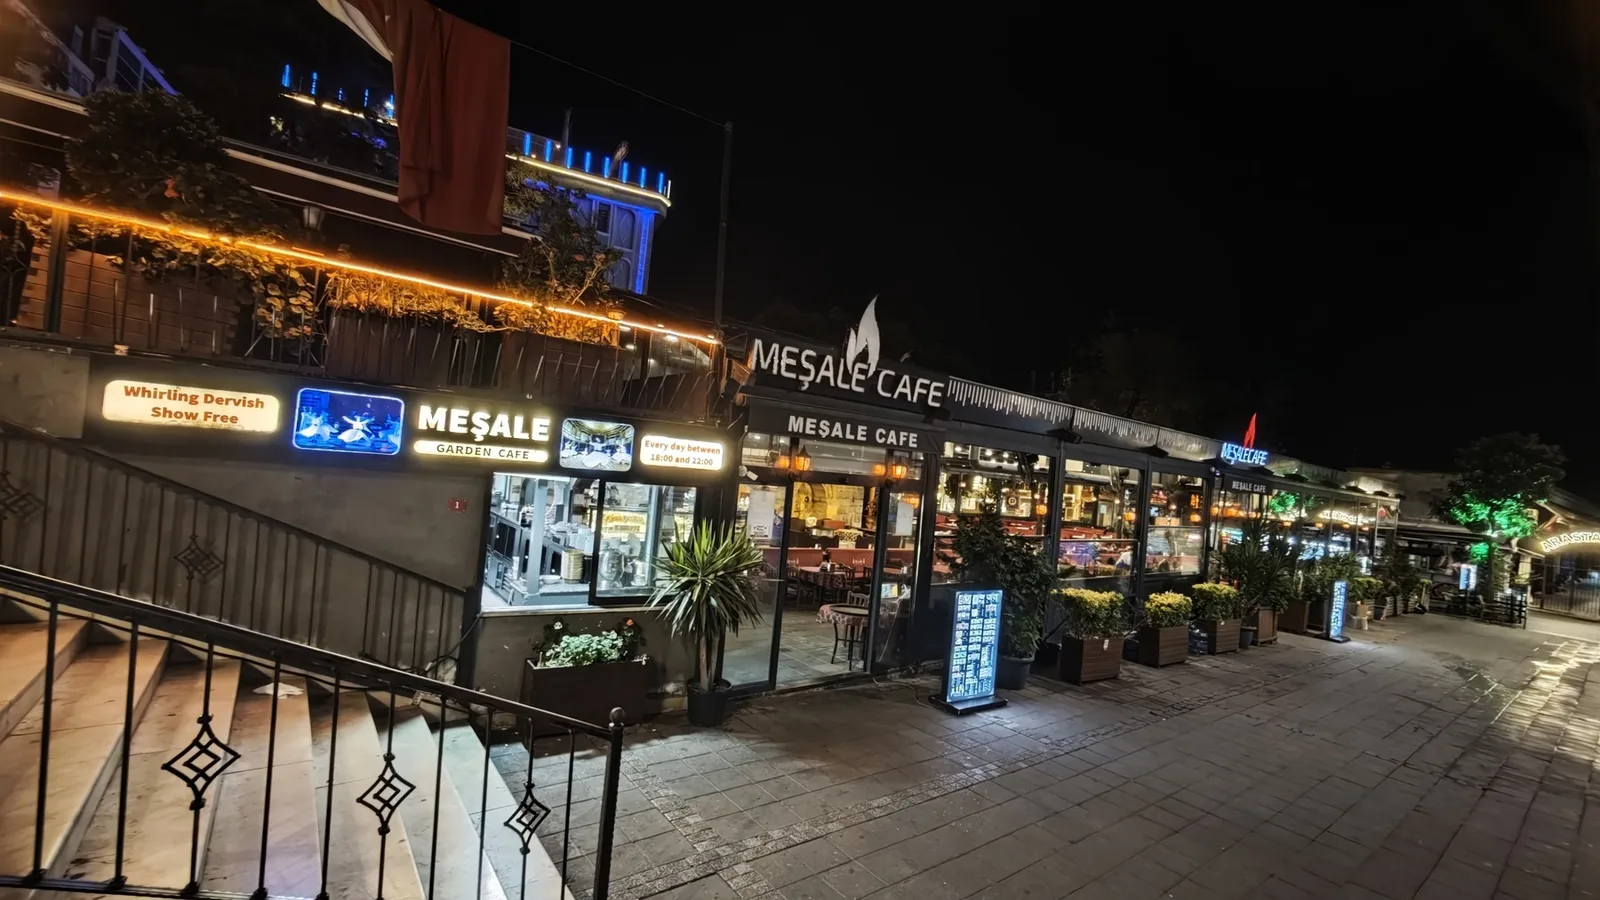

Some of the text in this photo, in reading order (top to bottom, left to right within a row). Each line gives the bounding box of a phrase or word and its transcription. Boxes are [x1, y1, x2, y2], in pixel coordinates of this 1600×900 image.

[751, 338, 945, 407] MEŞALE CAFE
[124, 385, 264, 409] Whirling Dervish
[151, 406, 239, 424] Show Free
[418, 405, 550, 442] MEŞALE
[788, 415, 918, 448] MEŞALE CAFE
[436, 444, 529, 459] GARDEN CAFE
[644, 440, 720, 454] Every day between
[650, 454, 714, 466] 18:00 and 22:00
[1253, 484, 1266, 493] CAFE
[455, 501, 460, 509] 1
[1541, 532, 1600, 552] ARASTA
